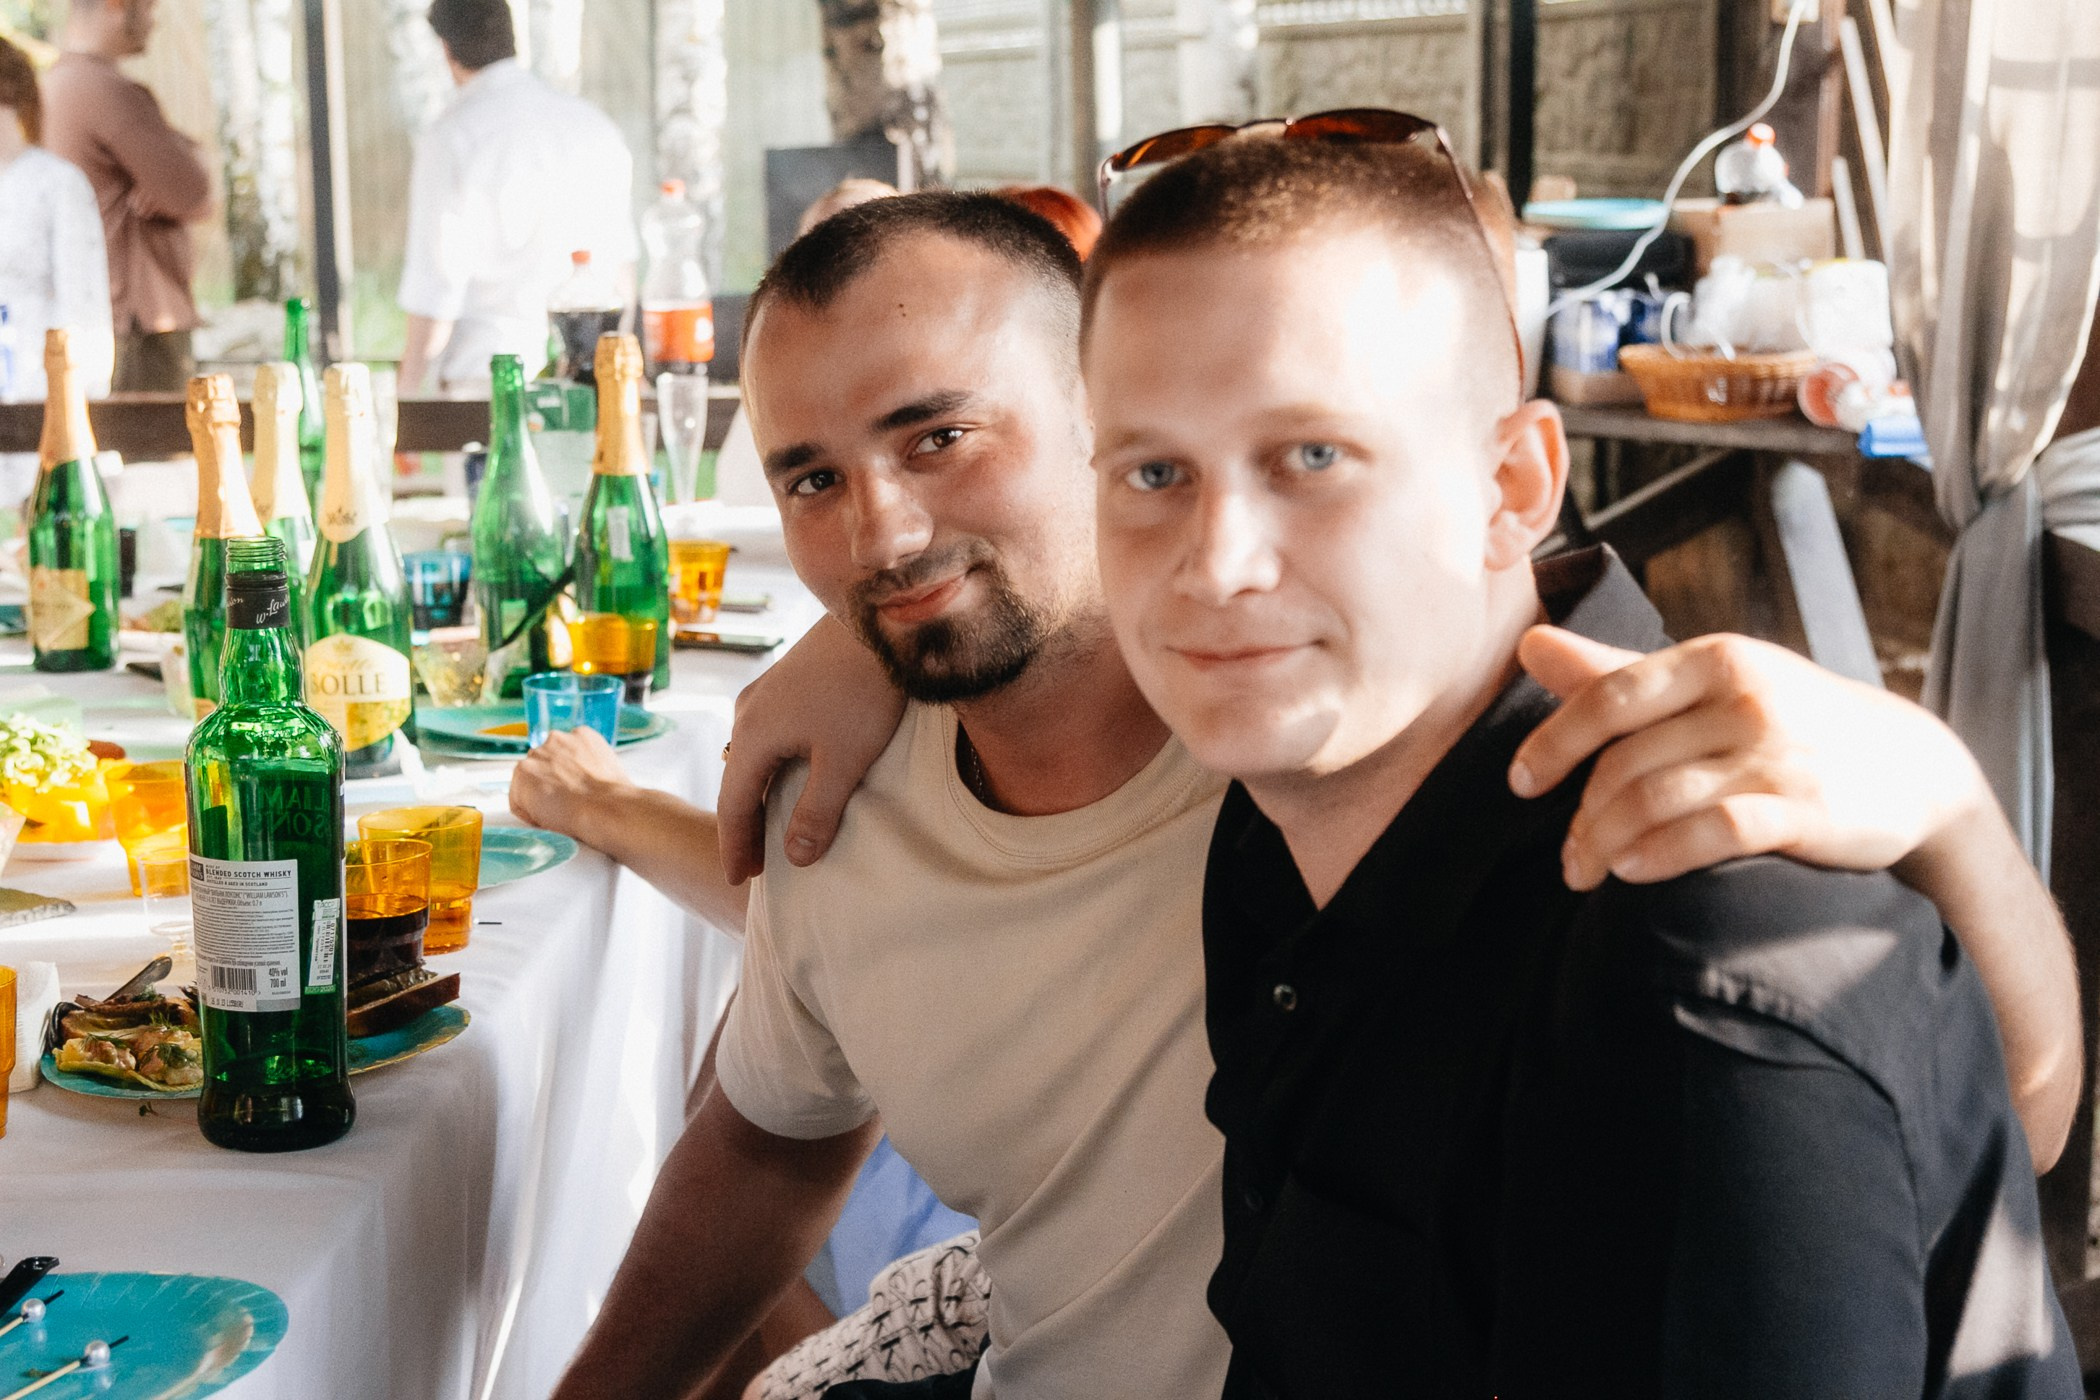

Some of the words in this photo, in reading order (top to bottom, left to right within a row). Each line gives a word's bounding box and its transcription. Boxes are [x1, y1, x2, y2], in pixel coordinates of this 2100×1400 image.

[206, 868, 232, 878] BLENDED
[234, 870, 261, 878] SCOTCH
[263, 870, 291, 878] WHISKY
[269, 967, 280, 976] 40%
[280, 967, 288, 976] vol
[270, 978, 280, 988] 700
[280, 977, 287, 987] ml
